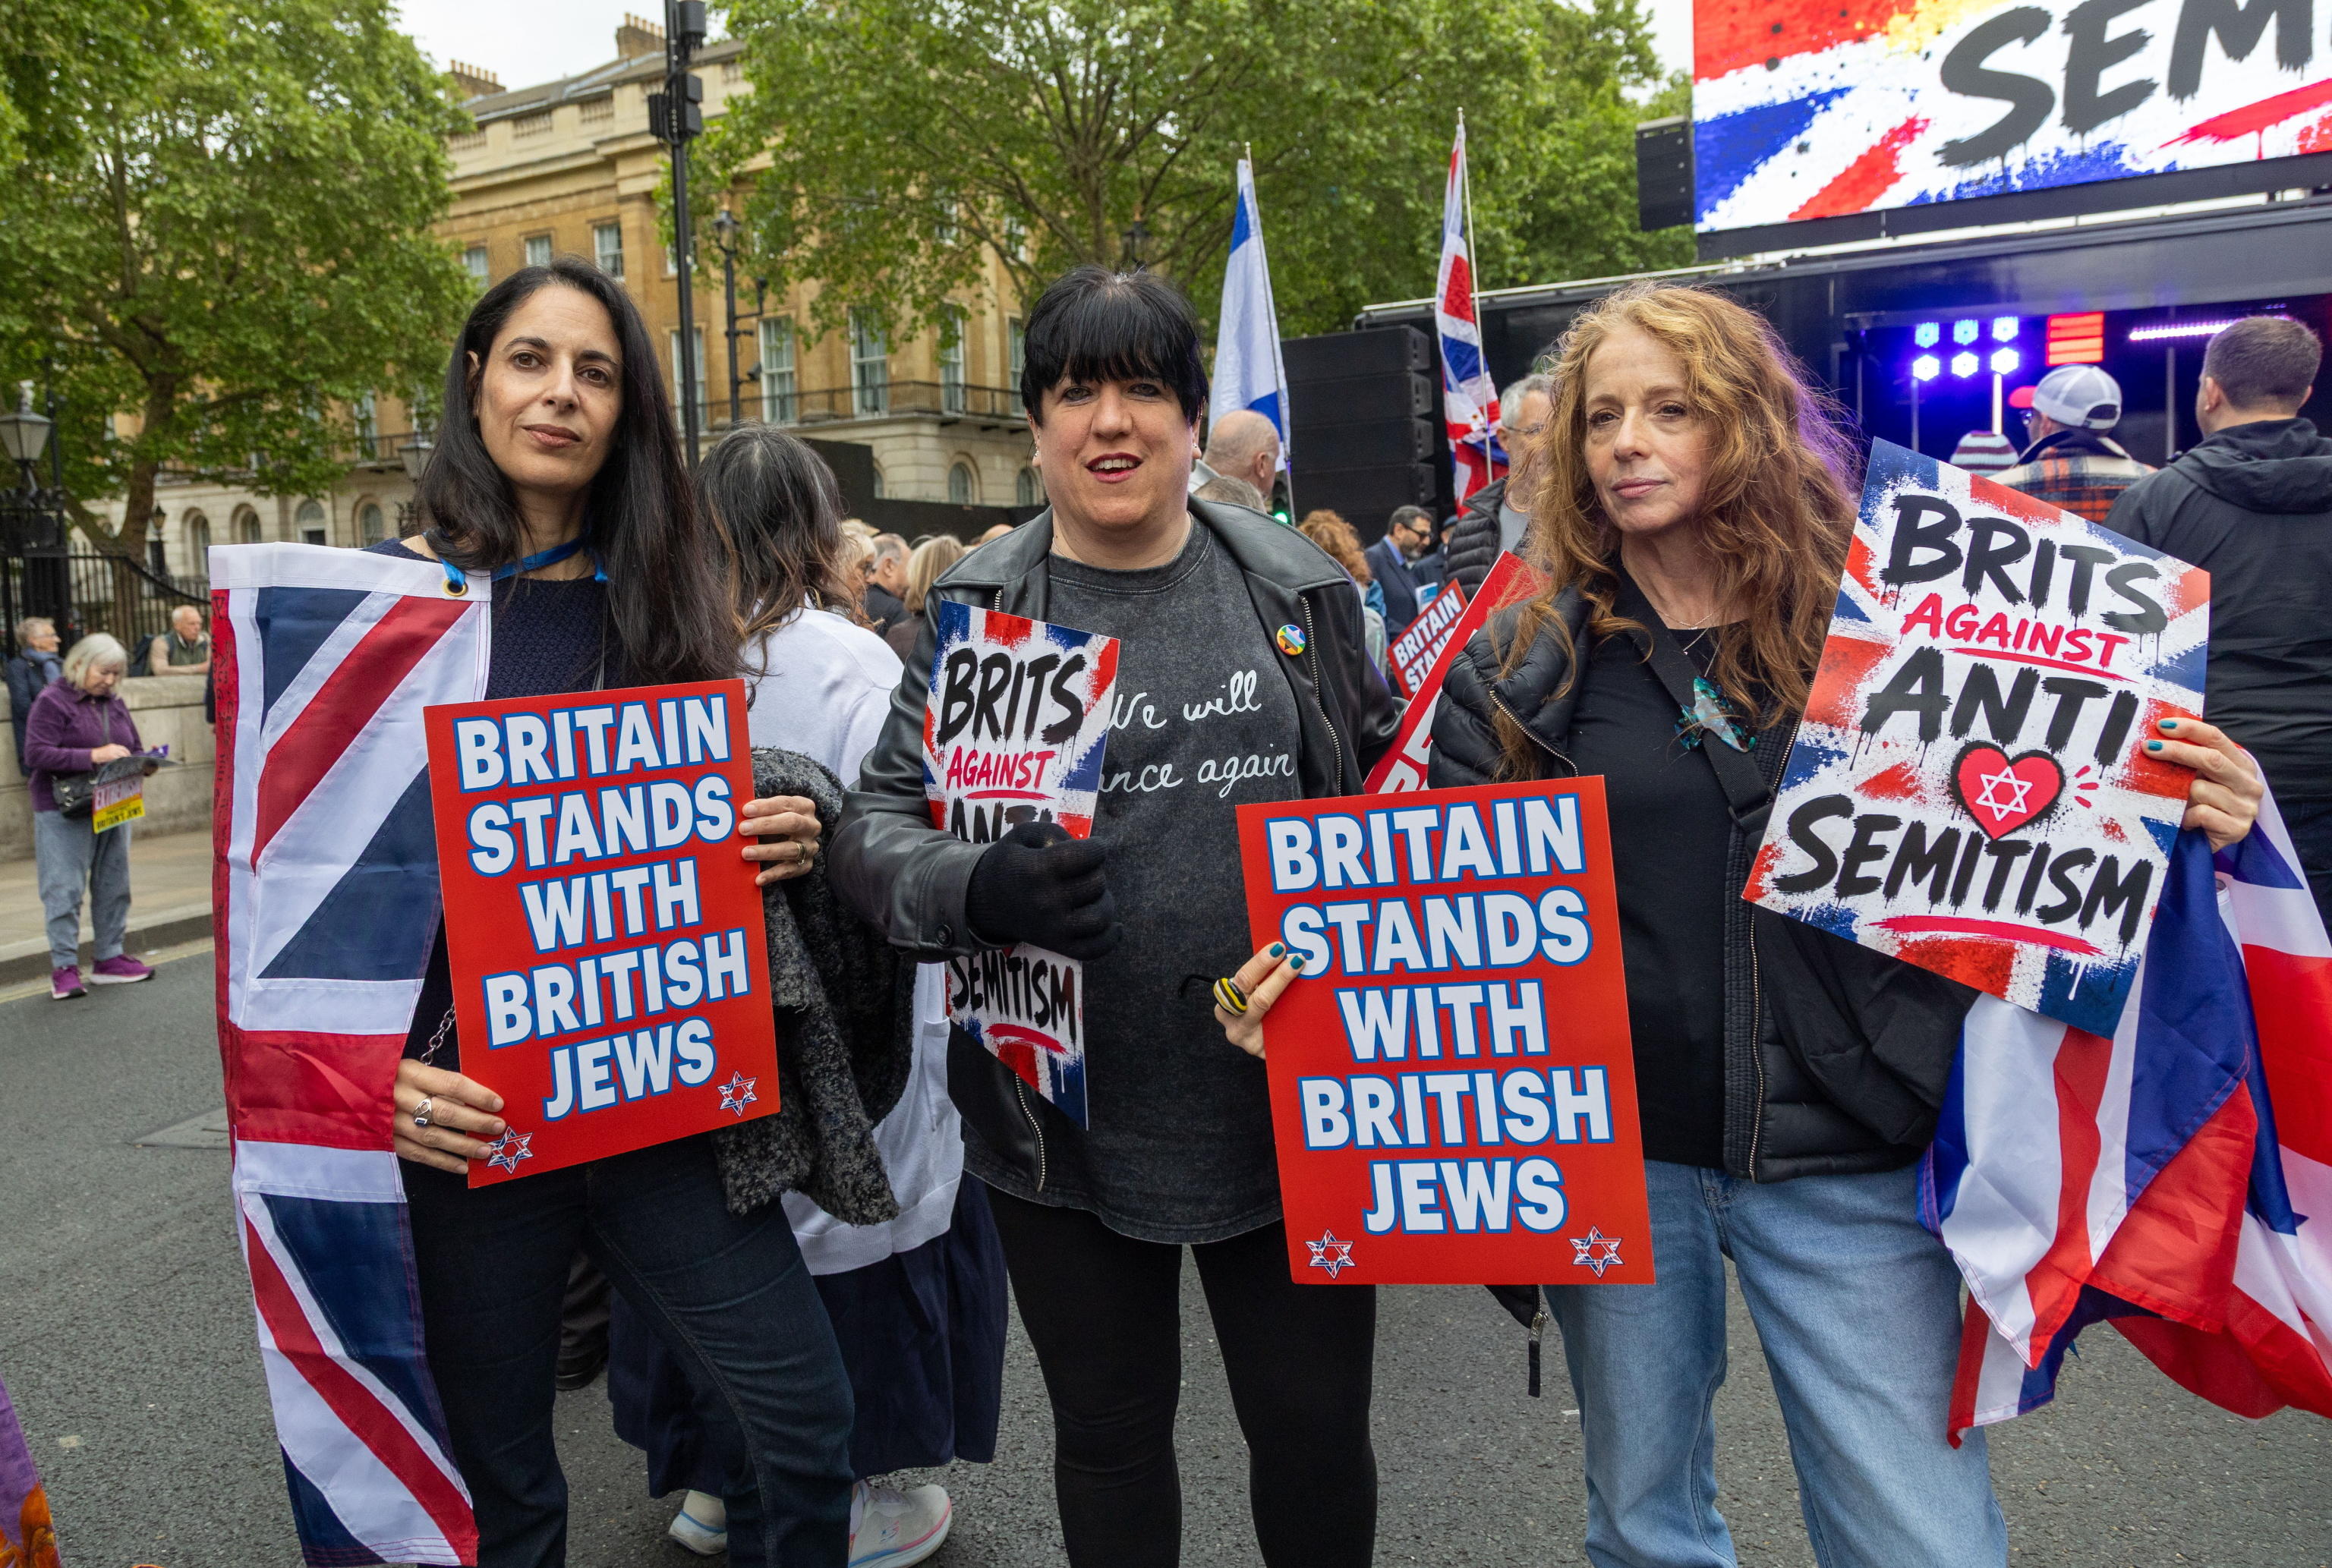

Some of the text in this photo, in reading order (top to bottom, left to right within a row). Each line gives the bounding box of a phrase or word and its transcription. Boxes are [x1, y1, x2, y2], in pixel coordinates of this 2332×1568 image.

[1934, 0, 2332, 168] SEM
[1880, 494, 2168, 634] BRITS
[1392, 588, 1463, 670] BRITAIN
[1404, 616, 1462, 693] STA
[1899, 593, 2127, 668] AGAINST
[936, 647, 1086, 745] BRITS
[1183, 669, 1262, 721] will
[1859, 647, 2138, 767] ANTI
[453, 694, 731, 793] BRITAIN
[947, 749, 1057, 789] AGAINST
[1098, 743, 1294, 798] nce again
[467, 773, 735, 877] STANDS
[1265, 794, 1587, 893] BRITAIN
[1773, 794, 2153, 944] SEMITISM
[518, 858, 702, 954] WITH
[1281, 886, 1592, 979] STANDS
[482, 928, 750, 1050] BRITISH
[950, 950, 1076, 1044] SEMITISM
[1336, 979, 1549, 1063] WITH
[543, 1016, 716, 1122] JEWS
[1298, 1066, 1614, 1151] BRITISH
[1363, 1156, 1567, 1235] JEWS
